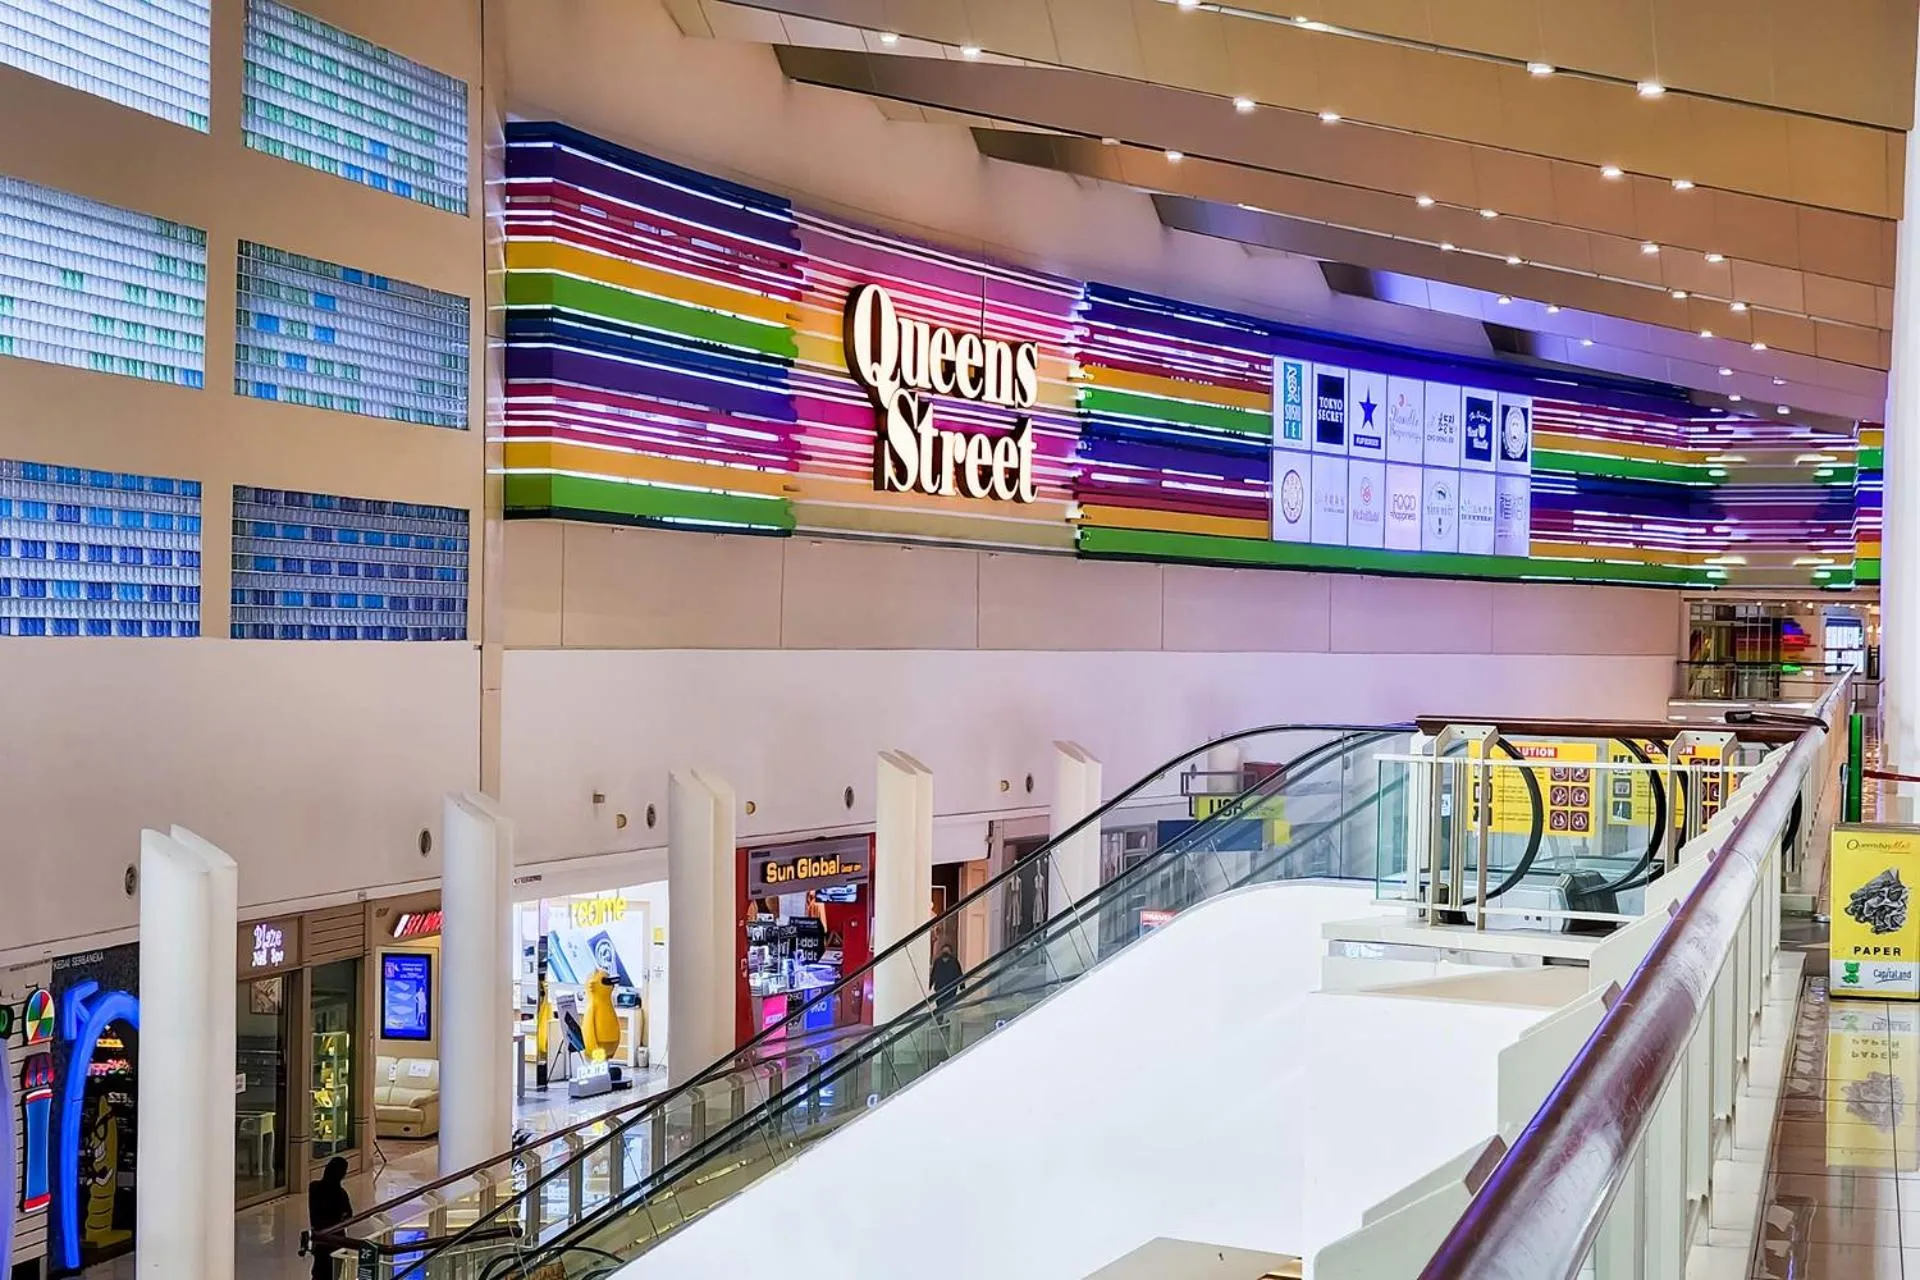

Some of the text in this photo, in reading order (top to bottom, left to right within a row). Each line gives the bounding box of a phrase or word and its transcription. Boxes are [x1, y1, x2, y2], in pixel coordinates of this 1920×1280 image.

[853, 284, 1038, 409] Queens
[1319, 396, 1344, 411] TOKYO
[1318, 409, 1344, 424] SECRET
[884, 388, 1039, 504] Street
[766, 855, 840, 883] Sun Global
[1854, 945, 1902, 956] PAPER
[1873, 967, 1912, 981] CapitaLand
